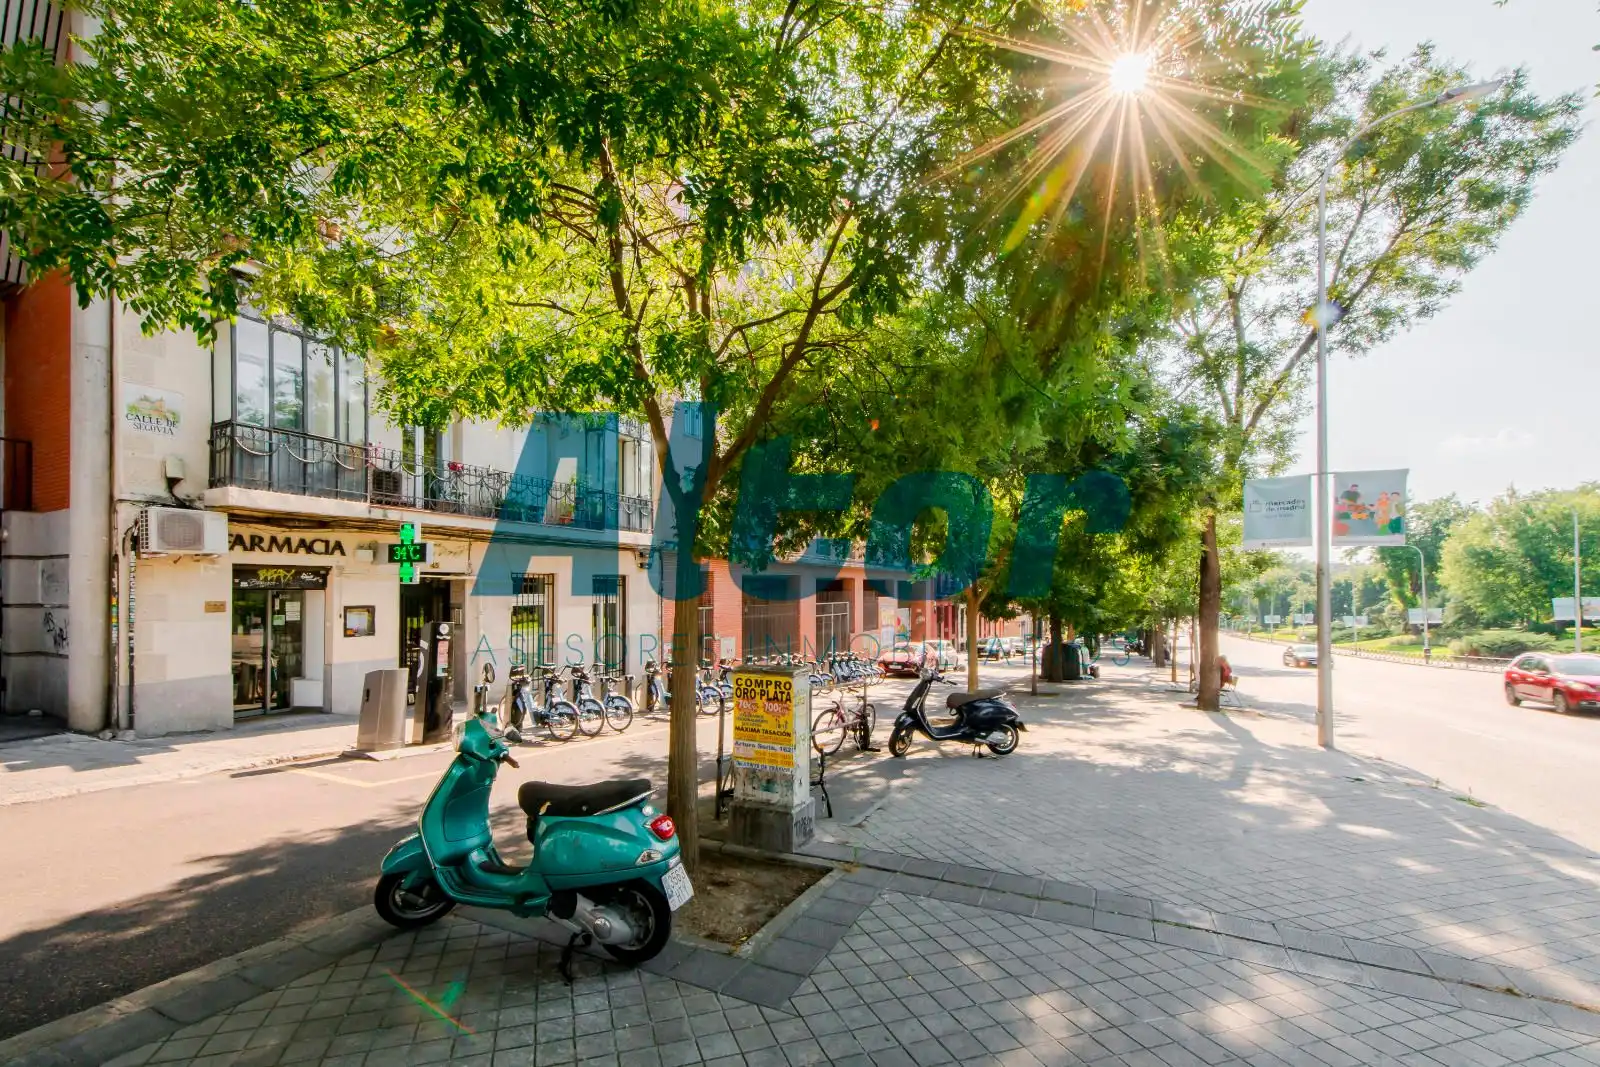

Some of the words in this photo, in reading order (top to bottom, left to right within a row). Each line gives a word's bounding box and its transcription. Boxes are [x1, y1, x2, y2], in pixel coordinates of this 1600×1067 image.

[126, 413, 162, 426] CALLE
[166, 417, 178, 428] DE
[132, 422, 174, 435] SEGOVIA
[735, 677, 793, 691] COMPRO
